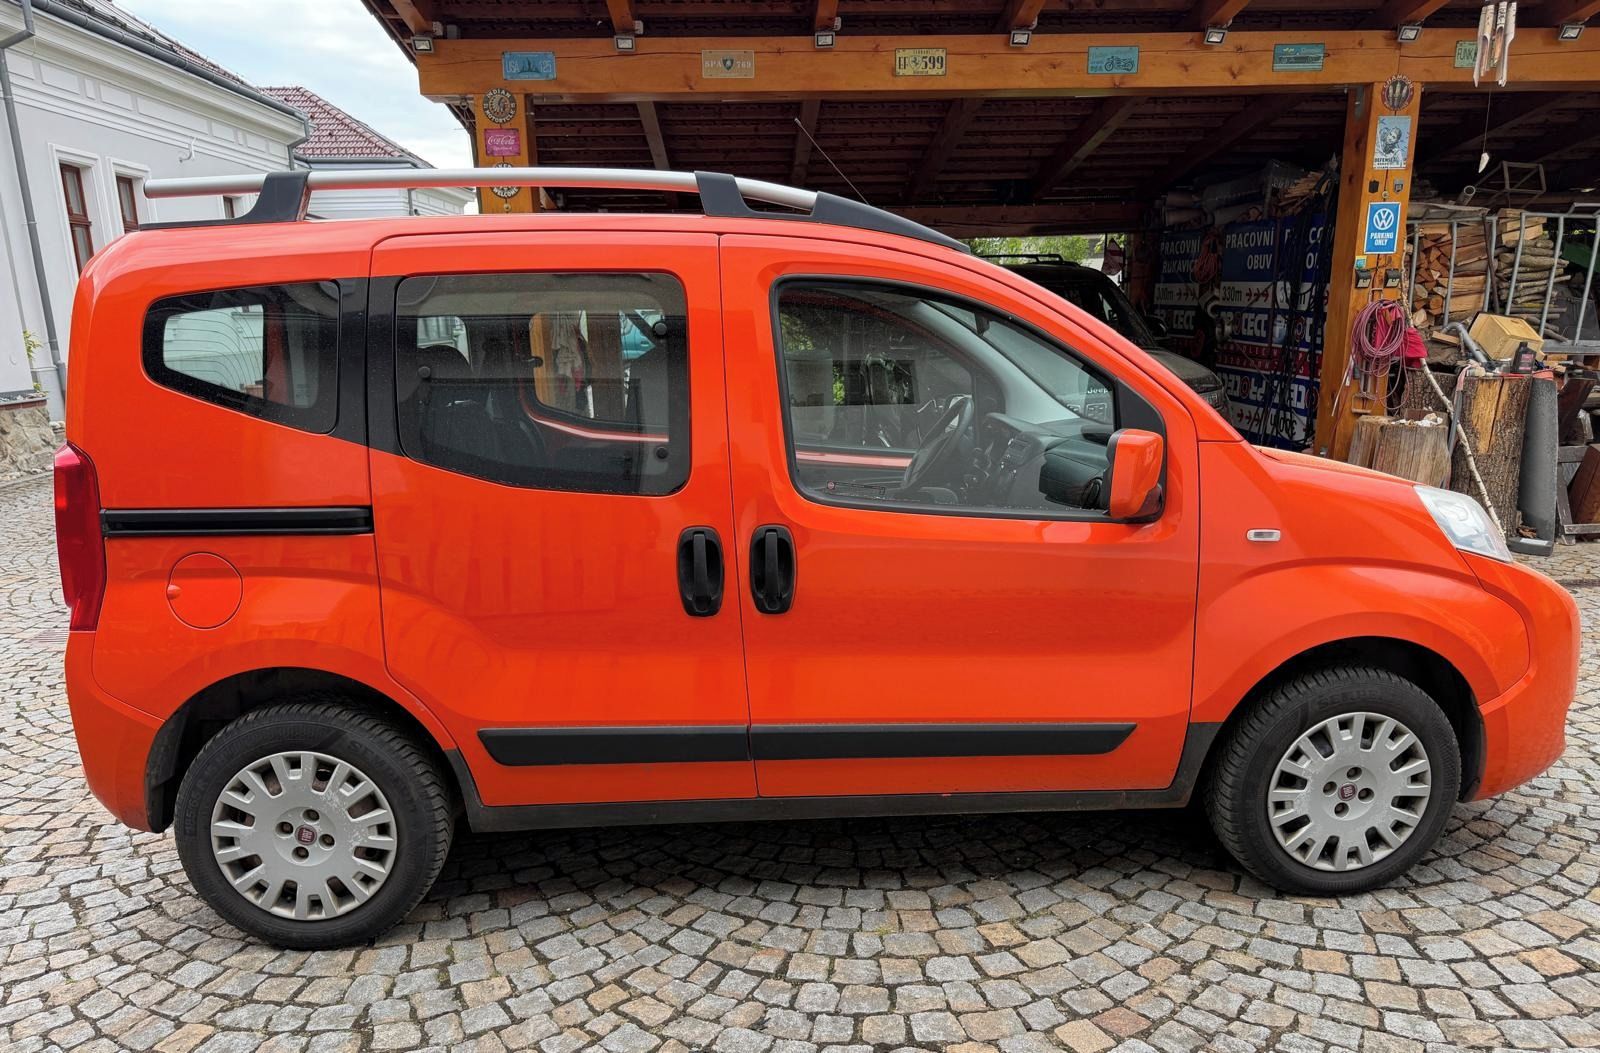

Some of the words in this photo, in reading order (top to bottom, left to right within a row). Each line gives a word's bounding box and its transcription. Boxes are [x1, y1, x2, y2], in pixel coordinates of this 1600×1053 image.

[921, 55, 944, 70] 599
[486, 88, 512, 98] INDIAN
[1225, 228, 1274, 249] PRACOVNÍ
[1160, 238, 1200, 255] PRACOVNÍ
[1162, 259, 1198, 274] RUKAVIC
[1247, 254, 1272, 270] OBUV
[1222, 286, 1242, 301] 330m
